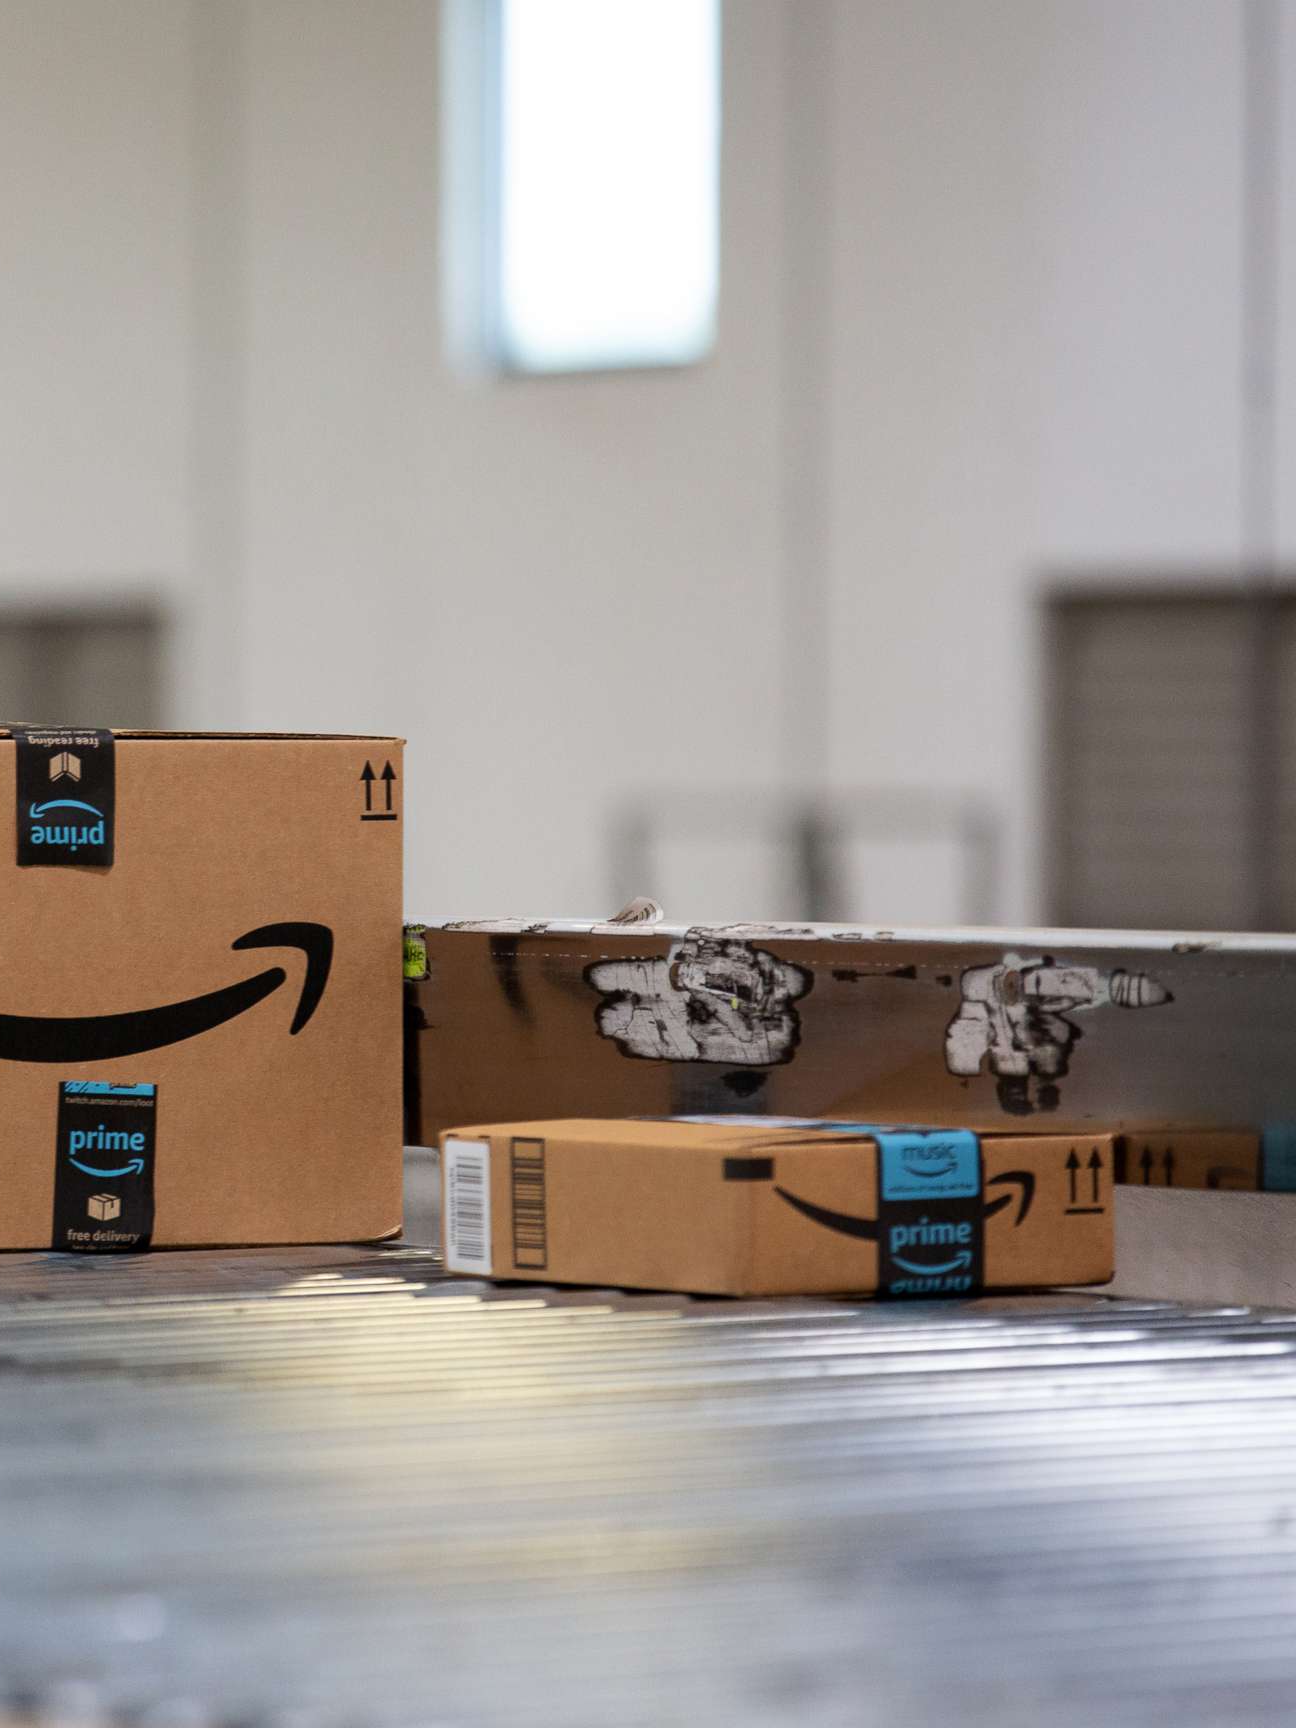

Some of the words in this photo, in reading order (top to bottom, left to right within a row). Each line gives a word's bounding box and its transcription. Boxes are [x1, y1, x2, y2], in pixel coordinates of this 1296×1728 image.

[27, 736, 73, 748] reading
[75, 737, 100, 748] free
[31, 821, 105, 851] prime
[68, 1124, 145, 1155] prime
[902, 1144, 955, 1160] music
[67, 1229, 91, 1241] free
[93, 1229, 140, 1244] delivery
[890, 1217, 972, 1252] prime
